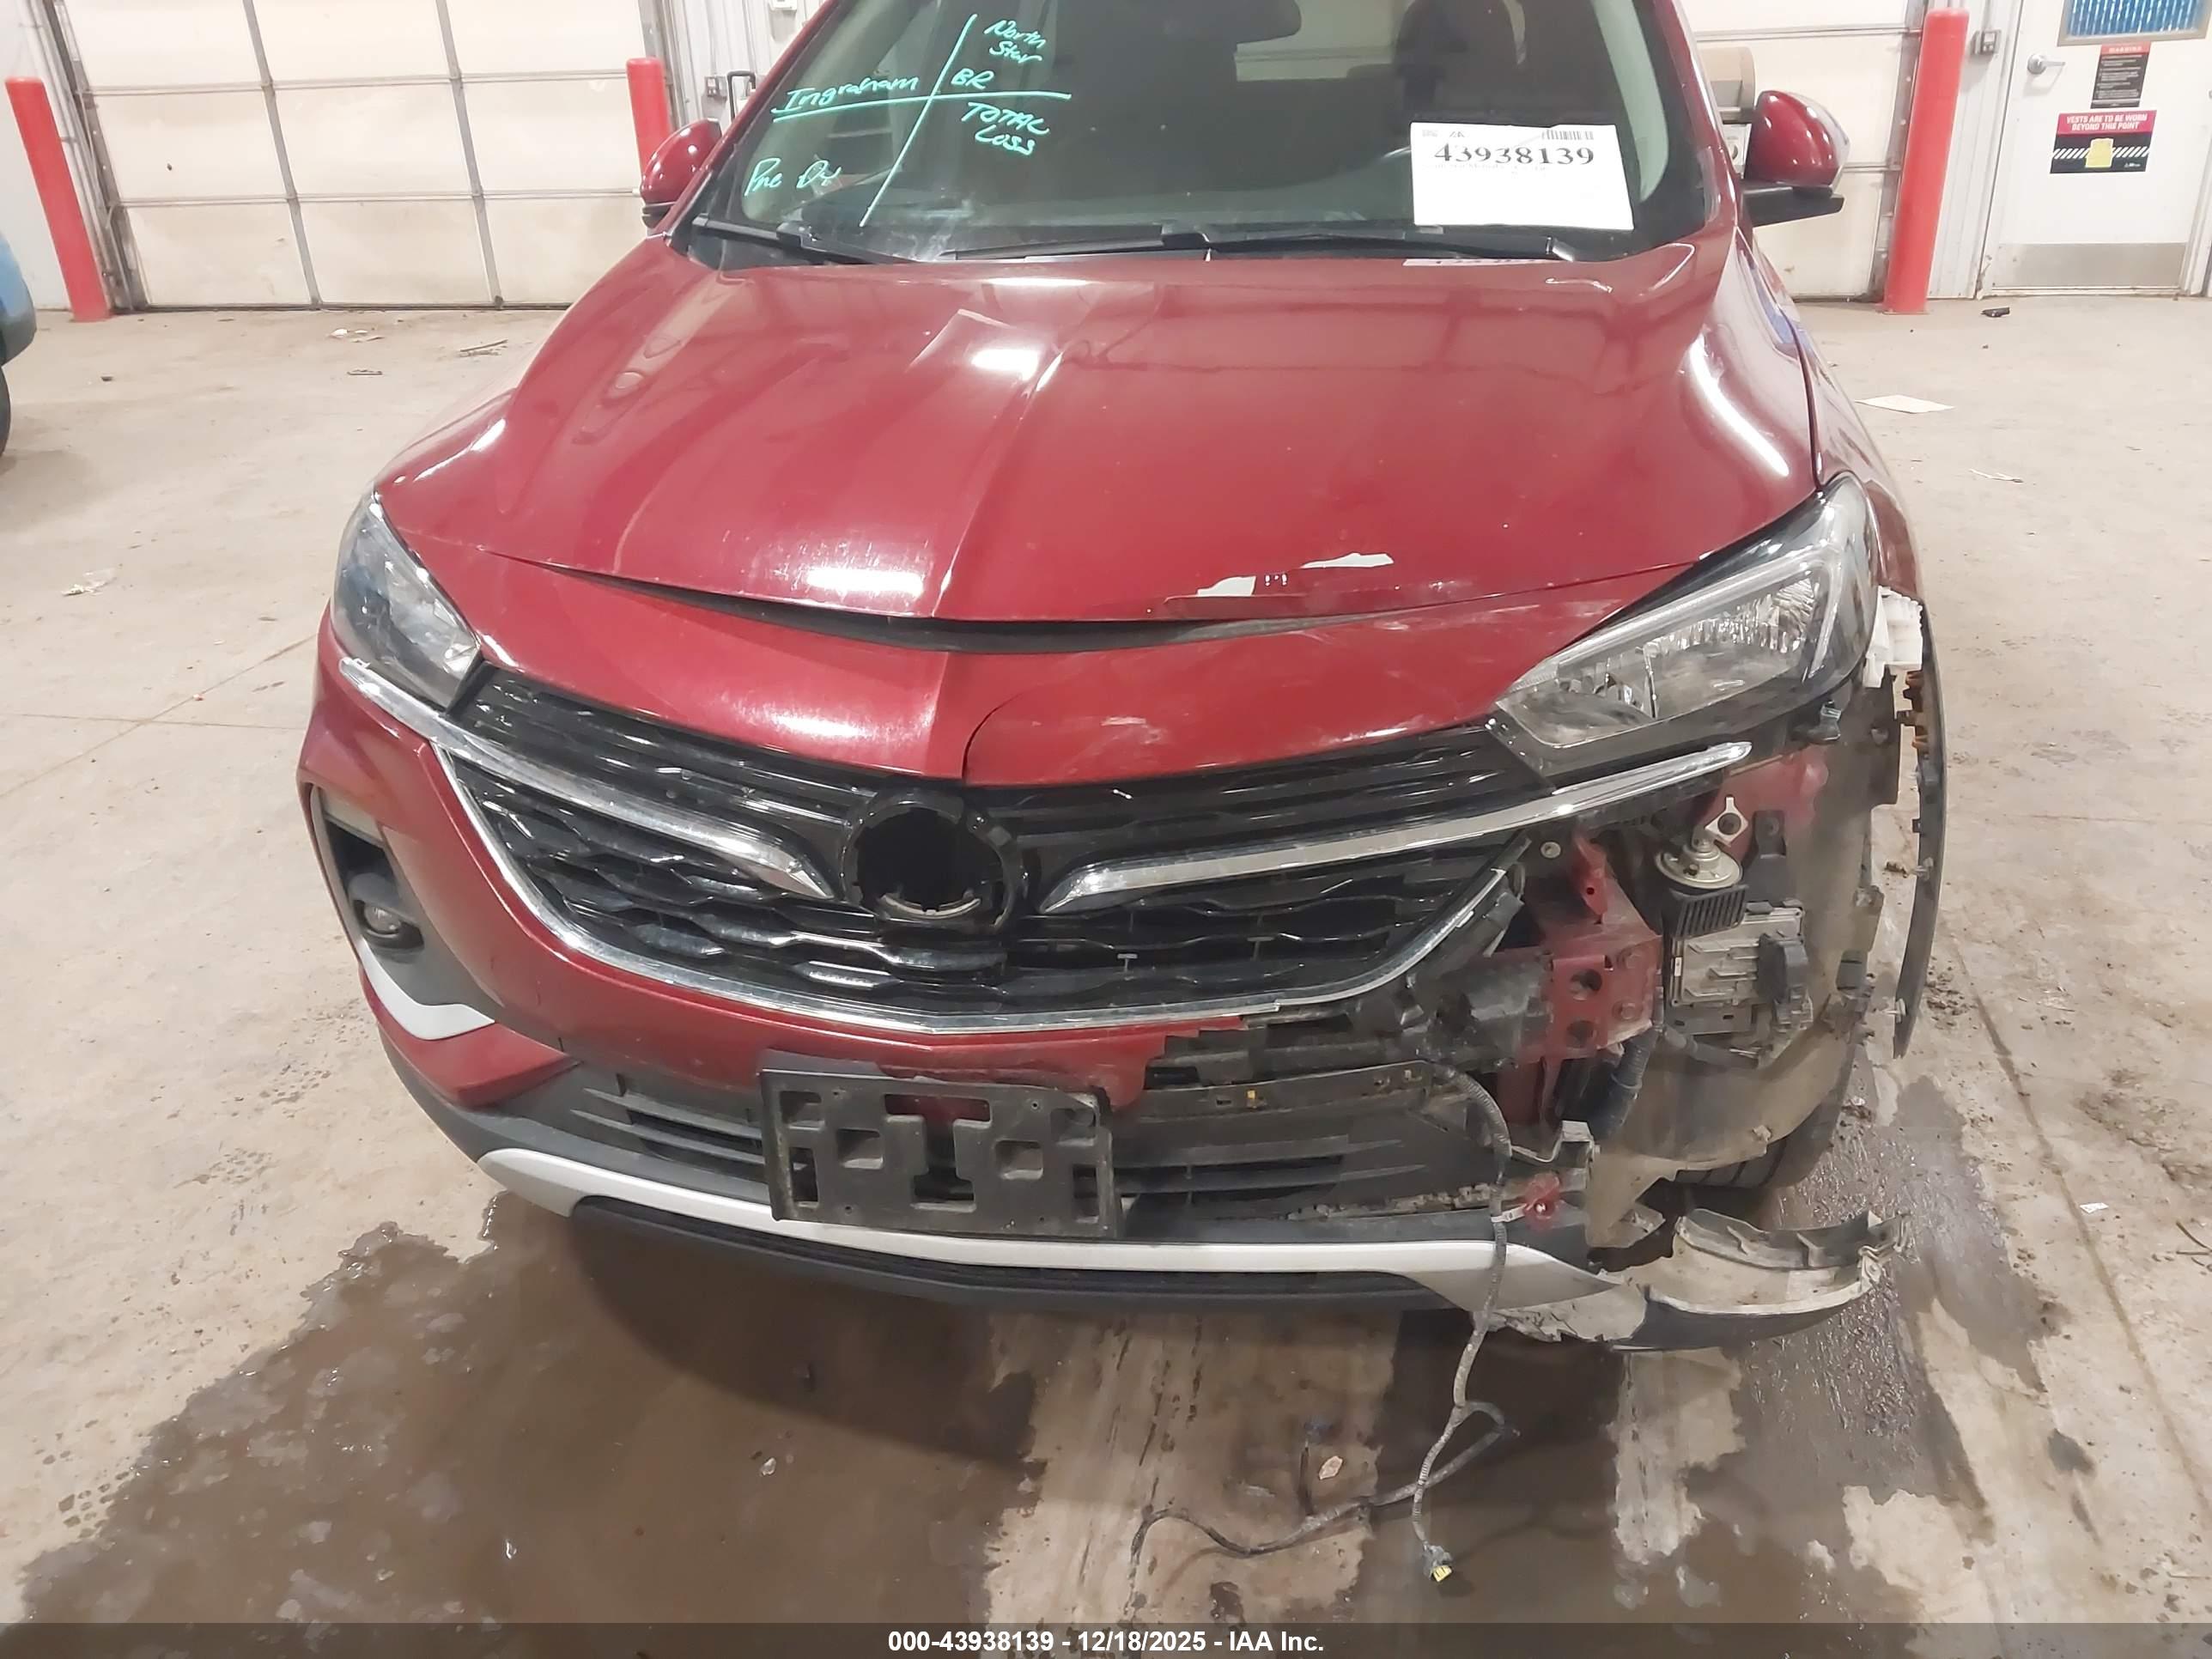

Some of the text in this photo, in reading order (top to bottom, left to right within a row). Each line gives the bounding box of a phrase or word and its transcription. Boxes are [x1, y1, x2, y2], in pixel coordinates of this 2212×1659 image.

[951, 68, 994, 89] BR
[2118, 121, 2140, 130] POINT
[1434, 143, 1594, 164] 43938139
